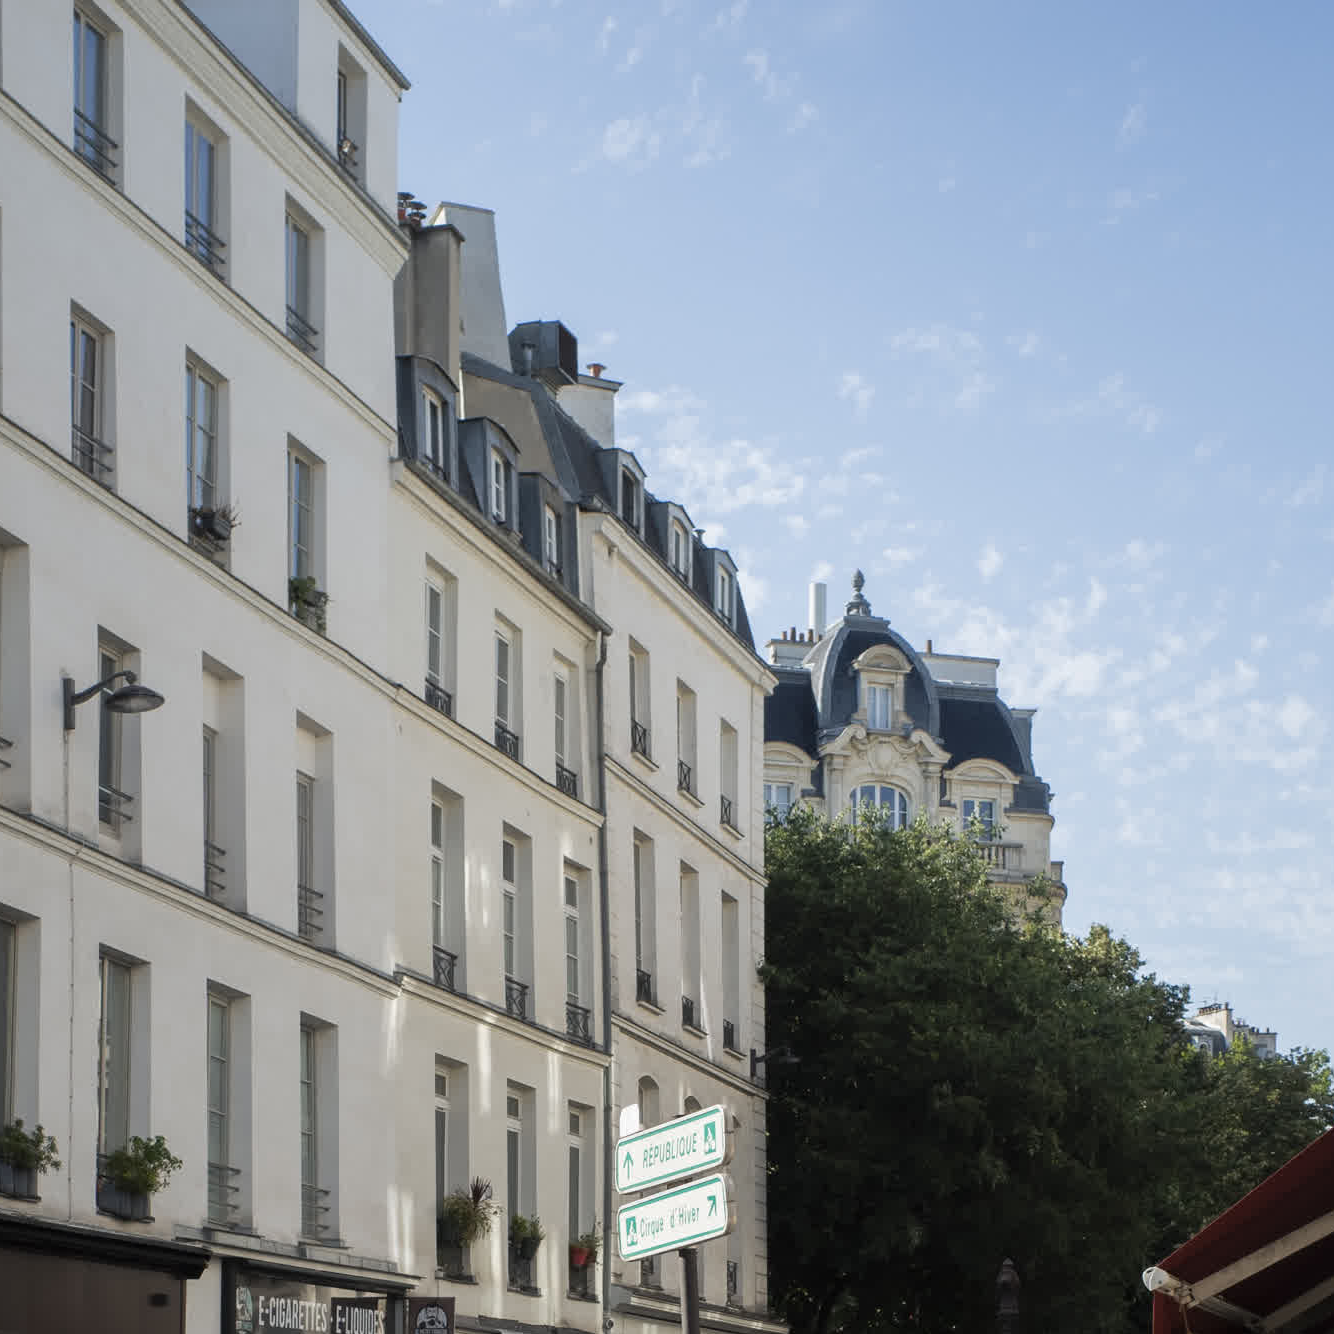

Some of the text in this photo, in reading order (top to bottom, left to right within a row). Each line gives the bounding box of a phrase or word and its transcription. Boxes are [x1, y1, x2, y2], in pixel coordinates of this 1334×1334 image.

[642, 1132, 698, 1169] RÉPUBLIQUE
[639, 1217, 664, 1239] Cirque
[258, 1295, 328, 1333] E-CIGARETTES
